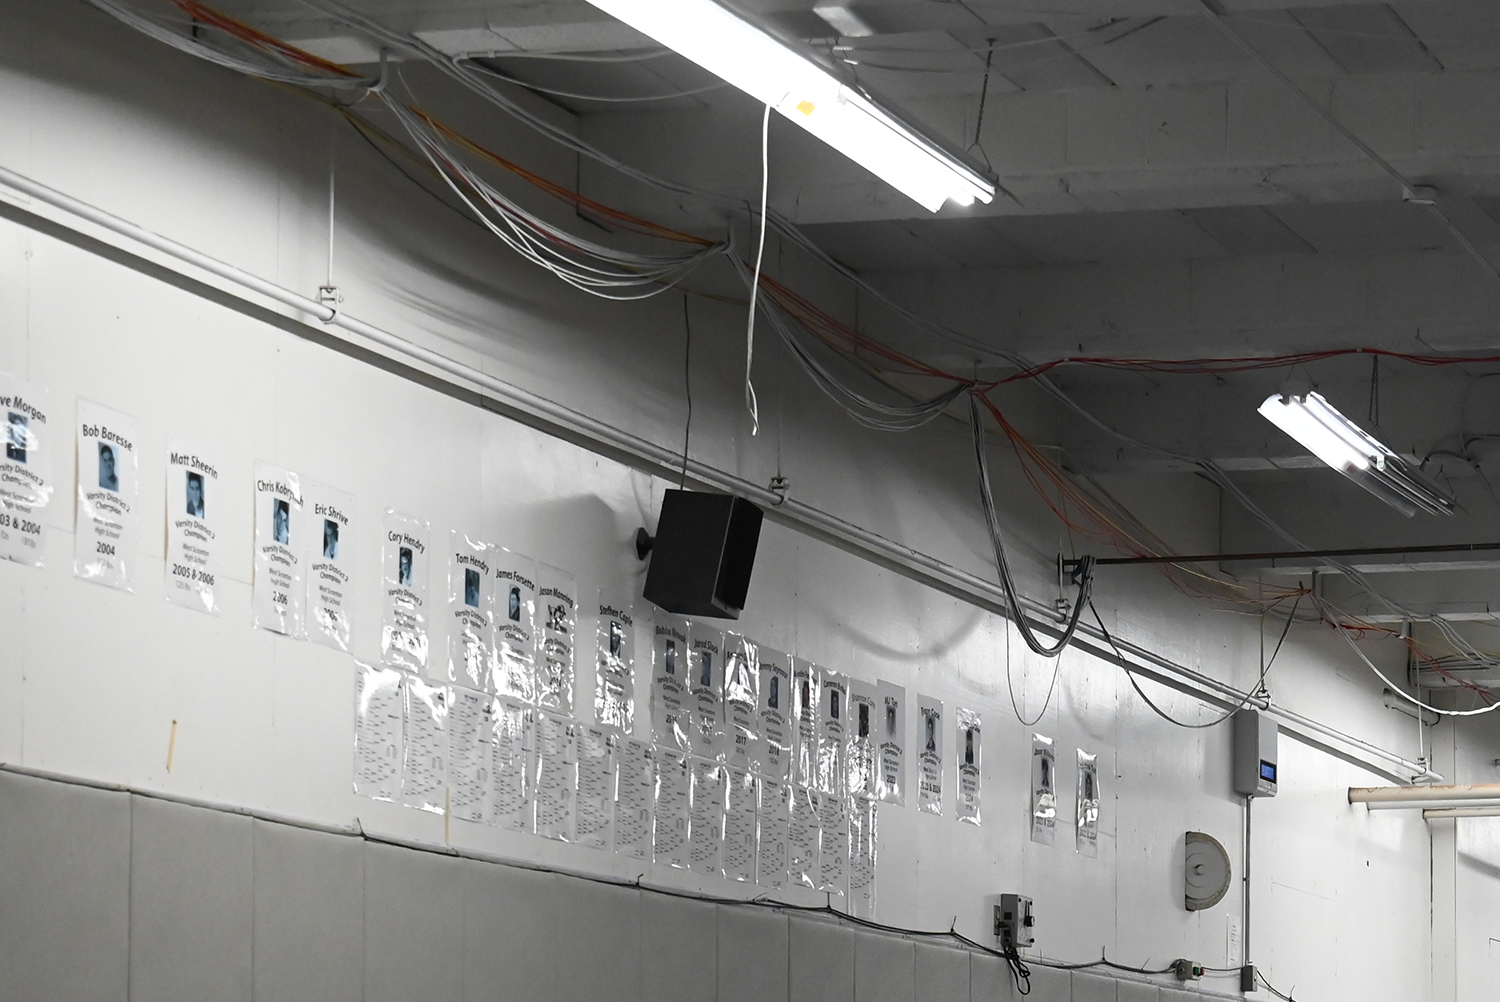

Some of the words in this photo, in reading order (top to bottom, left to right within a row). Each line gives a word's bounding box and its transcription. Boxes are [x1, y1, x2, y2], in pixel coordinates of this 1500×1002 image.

[13, 396, 47, 424] Morgan
[82, 424, 99, 437] Bob
[14, 464, 39, 483] District
[170, 452, 190, 466] Matt
[190, 455, 218, 480] Sheerin
[257, 480, 275, 492] Chris
[315, 503, 327, 516] Eric
[328, 506, 349, 526] Shrive
[21, 518, 41, 536] 2004
[96, 541, 116, 556] 2004
[388, 530, 403, 545] Cory
[403, 533, 425, 554] Hendry
[455, 553, 470, 564] Tom
[469, 555, 490, 575] Hendry
[172, 563, 191, 578] 2005
[191, 569, 198, 580] &
[198, 571, 215, 586] 2006
[495, 568, 513, 580] James
[539, 586, 553, 597] Jason
[553, 588, 574, 608] Manning
[735, 734, 747, 745] 2017
[768, 744, 780, 756] 2018
